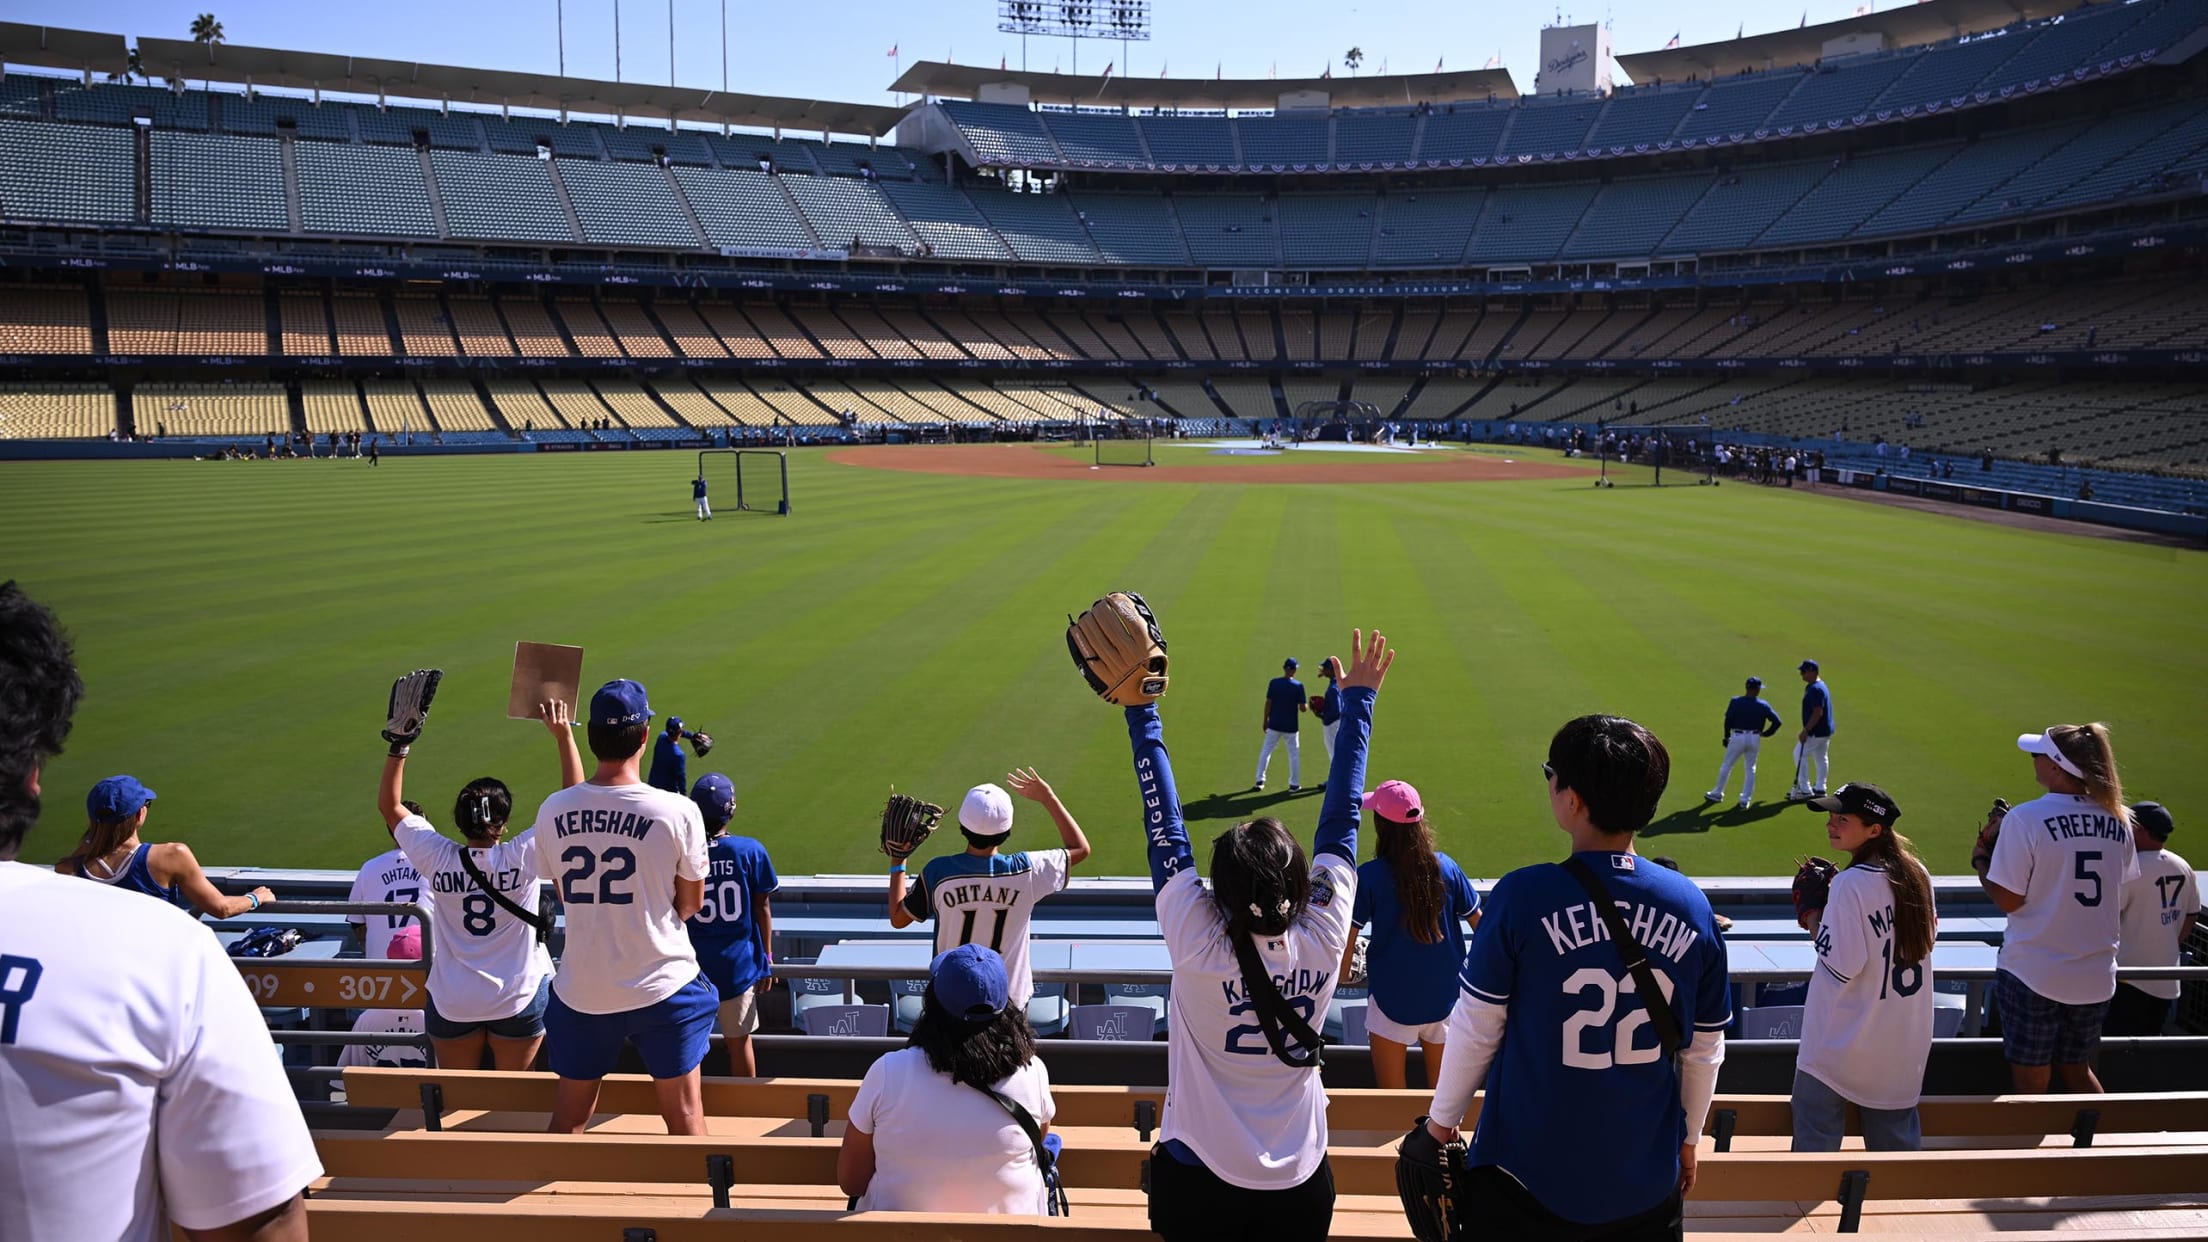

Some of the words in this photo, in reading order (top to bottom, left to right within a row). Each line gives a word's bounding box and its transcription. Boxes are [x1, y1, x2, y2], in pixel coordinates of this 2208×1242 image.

[1547, 50, 1588, 73] Dodgers
[1138, 758, 1172, 847] ANGELES
[554, 810, 654, 841] KERSHAW
[2044, 814, 2126, 844] FREEMAN
[381, 867, 423, 886] OHTANI
[561, 846, 636, 905] 22
[707, 860, 734, 878] TTS
[2074, 851, 2102, 907] 5
[384, 888, 420, 928] 17
[694, 881, 742, 924] 50
[943, 884, 1020, 908] OHTANI
[2155, 874, 2186, 908] 17
[462, 894, 496, 936] 8
[959, 908, 1009, 954] 11
[1815, 924, 1832, 958] LA
[244, 974, 279, 999] 09
[339, 975, 393, 1000] 307
[1222, 968, 1330, 1004] KESHAW
[1562, 968, 1675, 1070] 22
